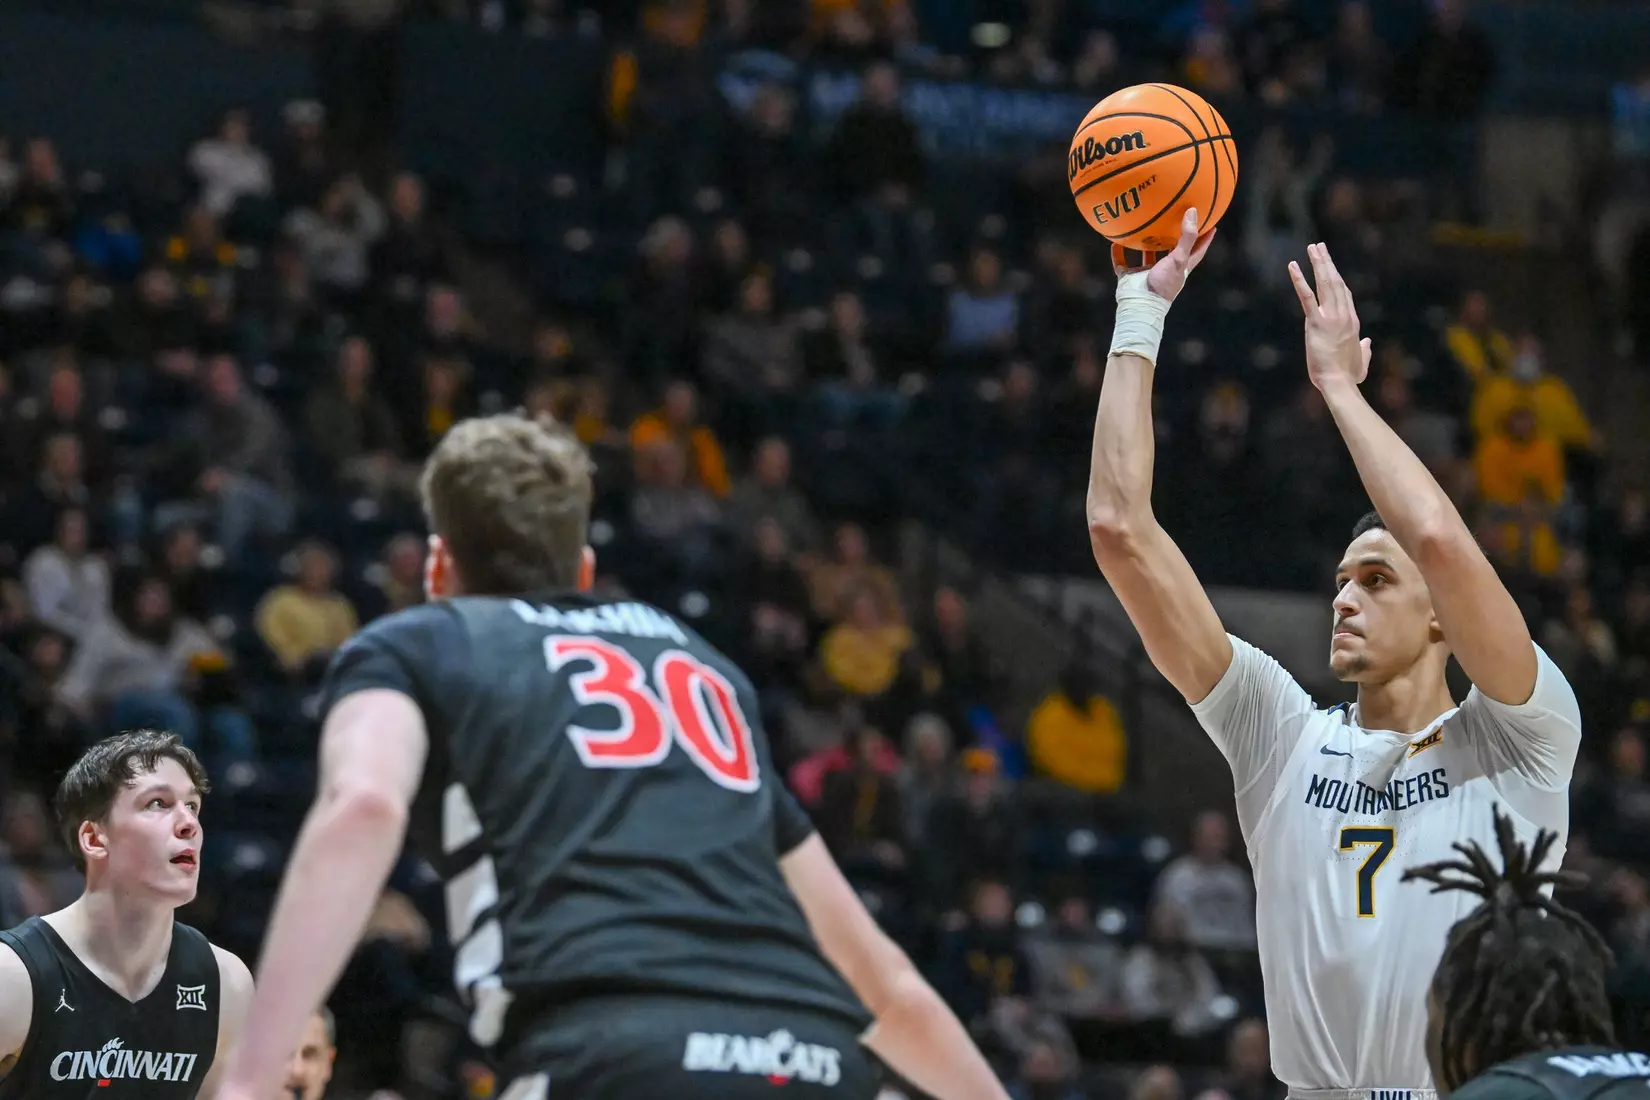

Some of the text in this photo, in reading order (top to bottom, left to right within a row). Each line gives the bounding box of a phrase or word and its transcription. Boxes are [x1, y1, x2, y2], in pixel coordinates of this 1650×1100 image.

[1138, 174, 1157, 192] NXT
[543, 634, 761, 793] 30
[1339, 825, 1396, 918] 7
[176, 984, 207, 1011] XII
[50, 1049, 198, 1082] CINCINNATI
[682, 1029, 841, 1086] BEARCATS
